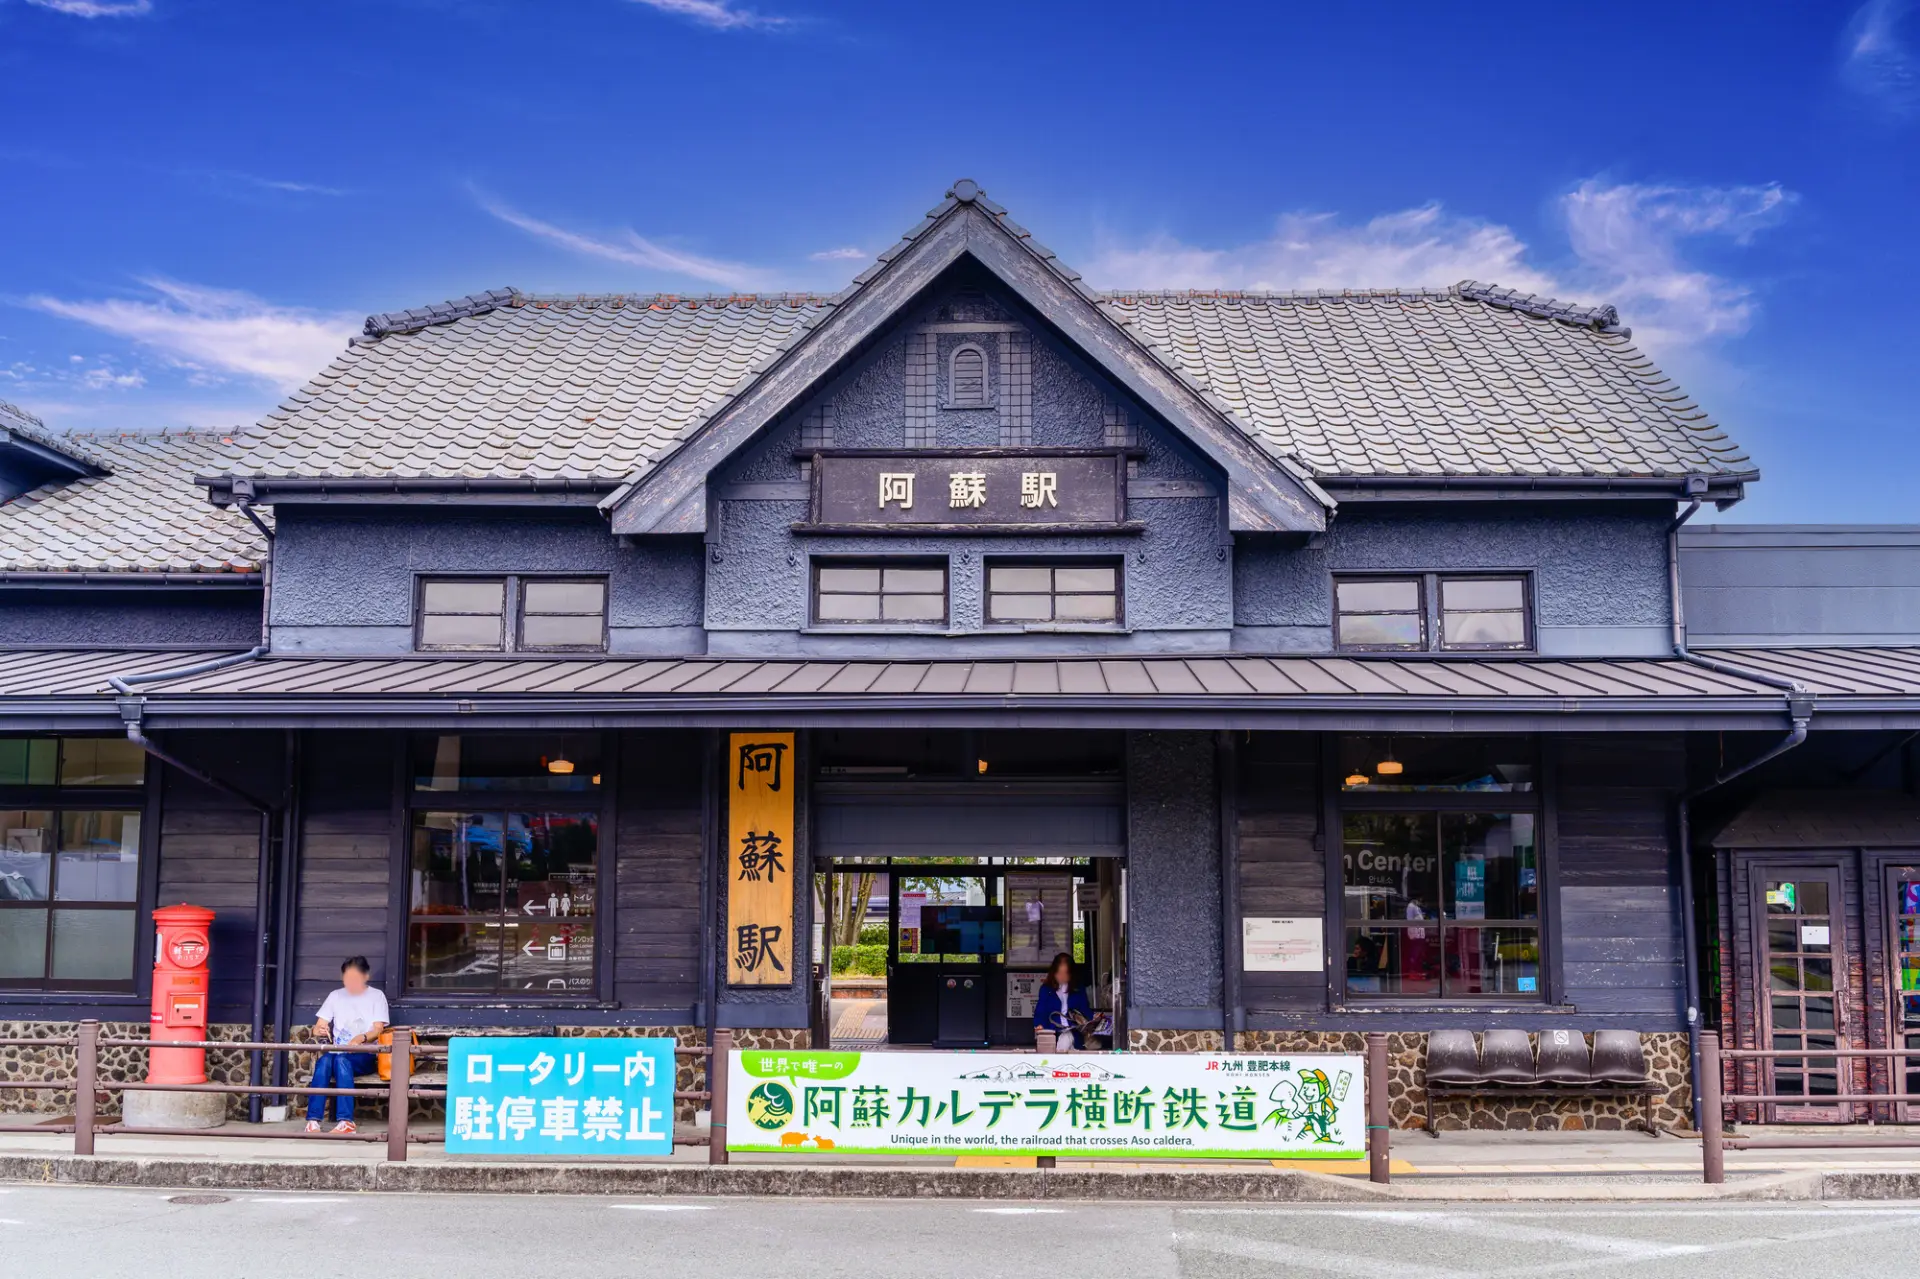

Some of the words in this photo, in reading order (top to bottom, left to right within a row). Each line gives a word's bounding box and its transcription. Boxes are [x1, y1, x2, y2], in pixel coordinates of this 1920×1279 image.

[878, 471, 1058, 509] 阿蘇駅
[734, 742, 788, 973] 阿蘇駅
[1357, 849, 1436, 873] Center
[573, 893, 593, 902] トイレ
[467, 1051, 656, 1086] ロータリー内
[758, 1057, 844, 1074] 世界で唯一の
[1205, 1061, 1219, 1071] JR
[1221, 1060, 1243, 1071] 九州
[1247, 1060, 1291, 1072] 豊肥本線
[453, 1096, 666, 1142] 駐停車禁止
[802, 1084, 1259, 1131] 阿蘇カルデラ横断鉄道
[890, 1134, 929, 1146] Unique
[931, 1134, 941, 1144] in
[944, 1134, 961, 1144] the
[964, 1134, 998, 1146] world,
[1001, 1135, 1018, 1145] the
[1021, 1134, 1063, 1145] railroad
[1065, 1135, 1087, 1145] that
[1089, 1136, 1128, 1145] crosses
[1130, 1135, 1151, 1145] Aso
[1153, 1135, 1195, 1146] caldera.
